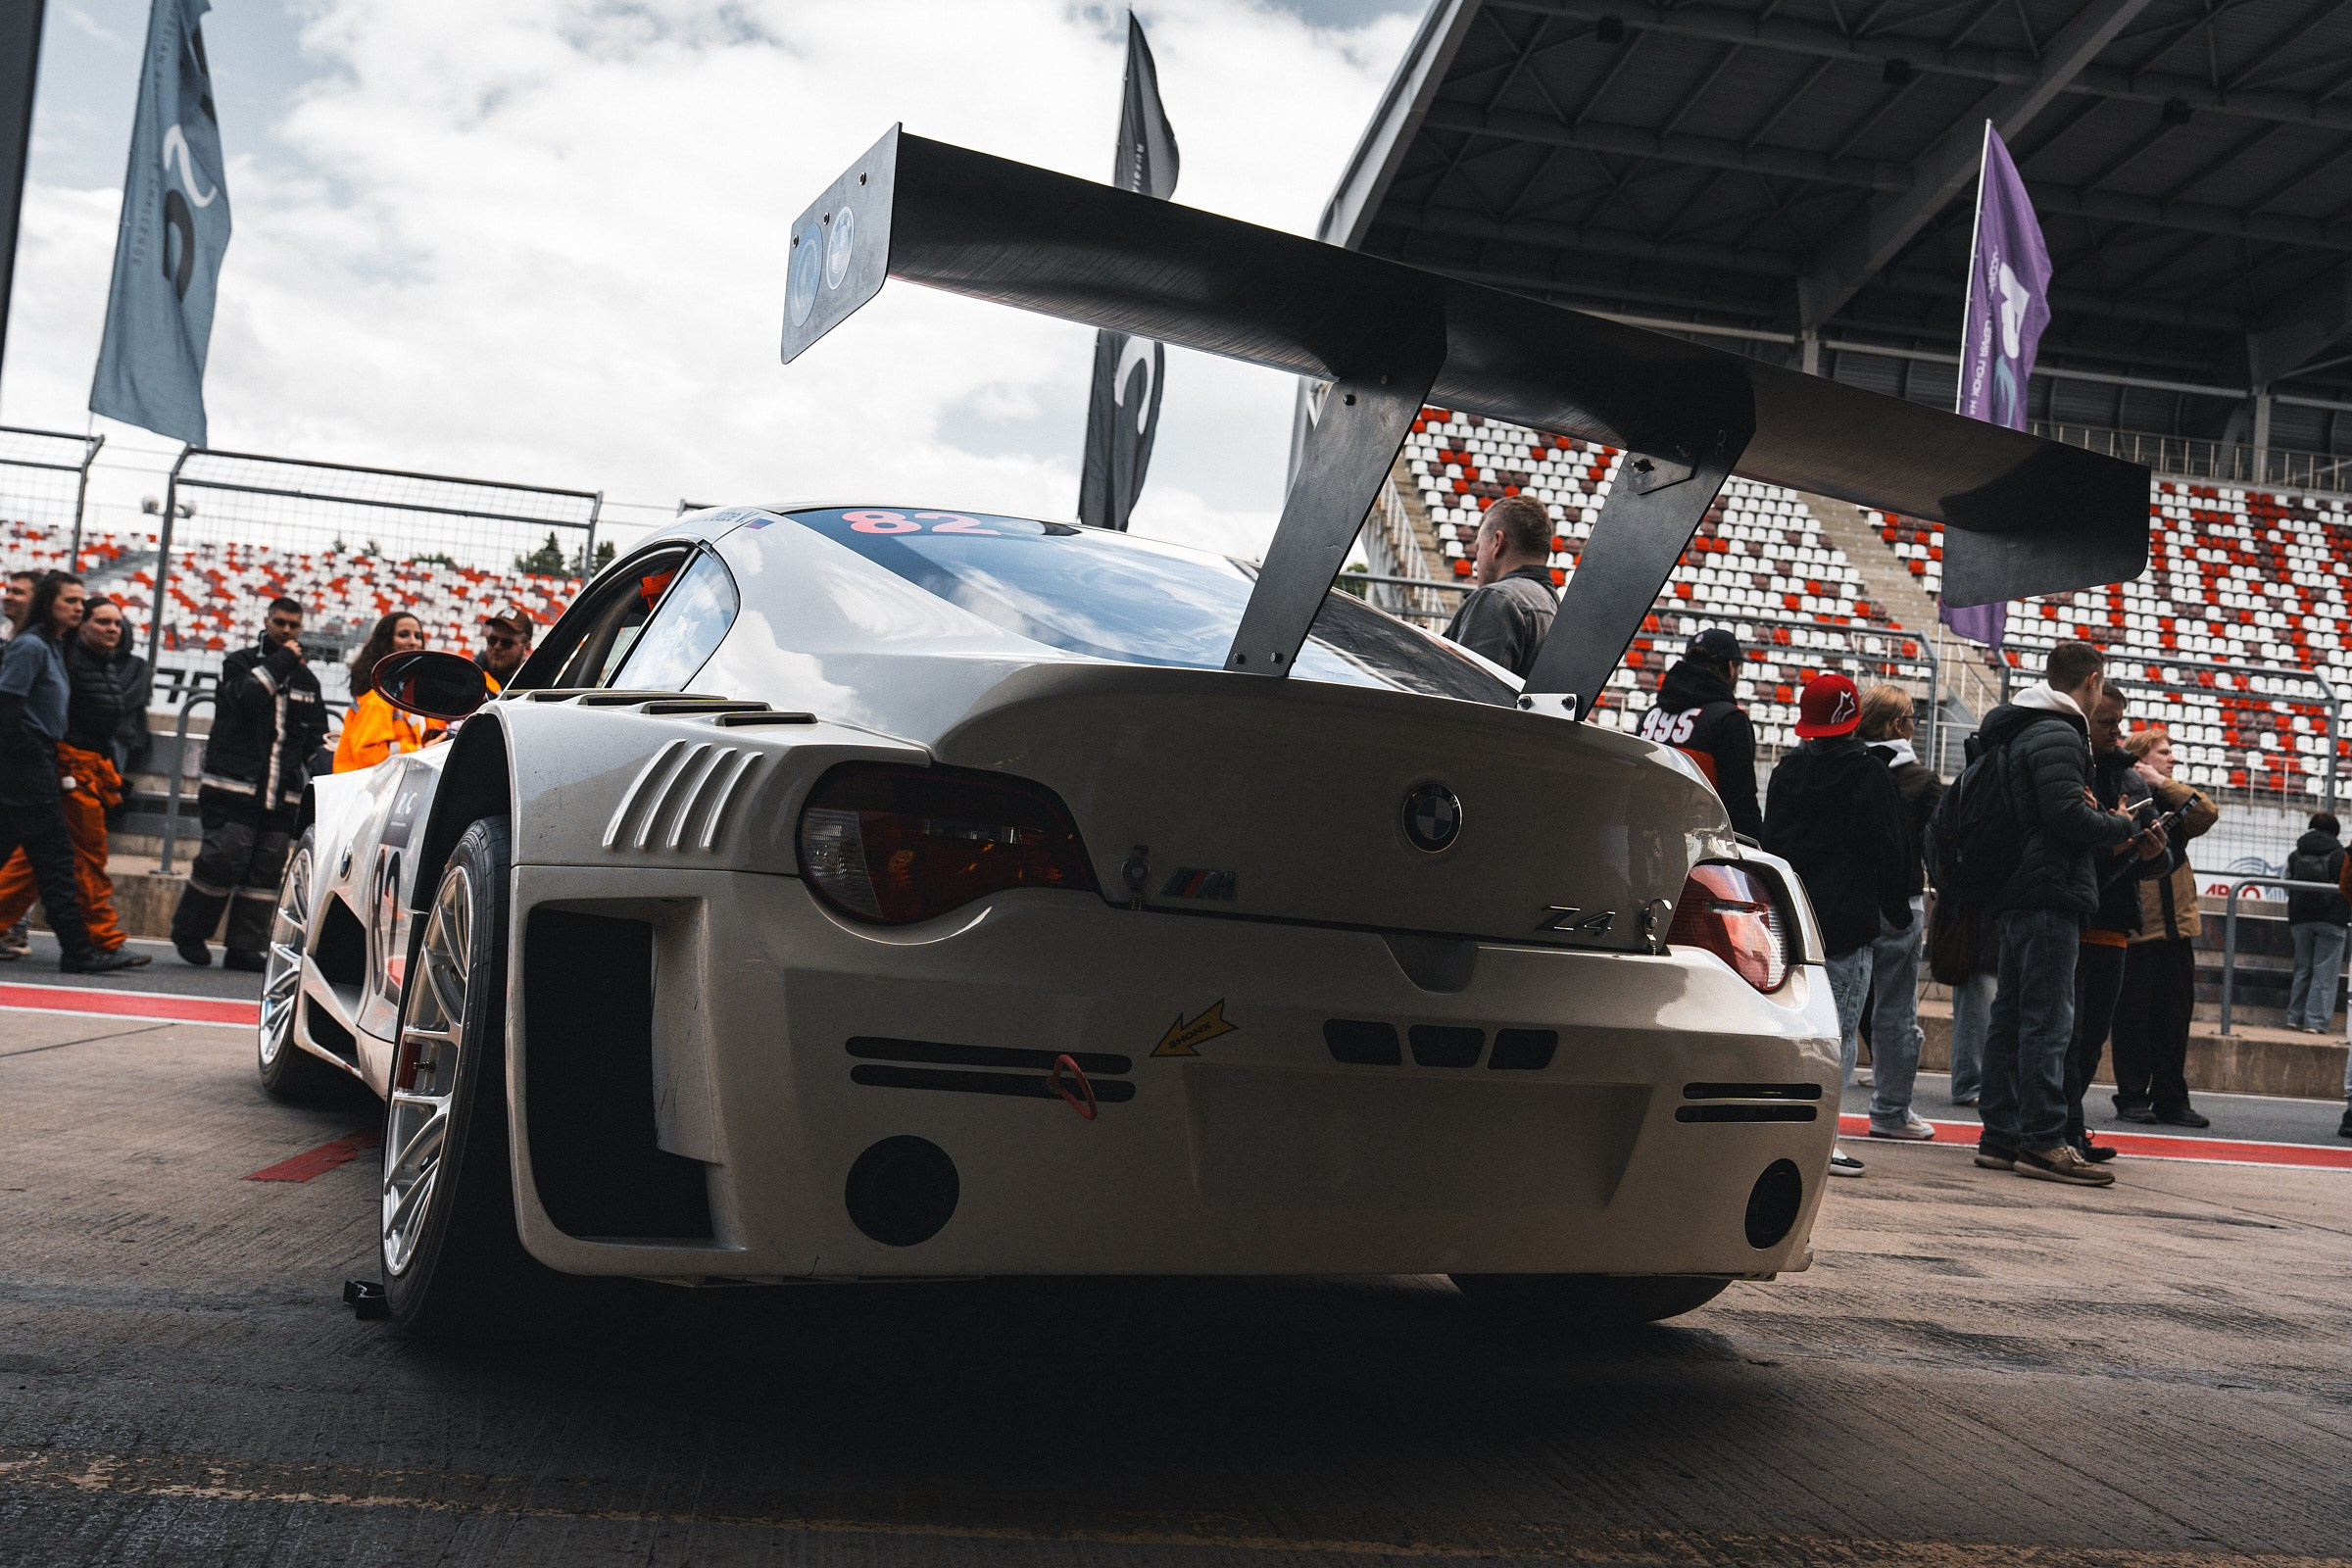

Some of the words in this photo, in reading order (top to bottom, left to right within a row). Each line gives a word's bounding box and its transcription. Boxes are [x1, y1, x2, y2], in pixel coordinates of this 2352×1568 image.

[1980, 319, 1992, 358] СЕРИЯ
[1971, 360, 1986, 398] ГОНОК
[841, 510, 1003, 536] 82
[1535, 905, 1617, 938] Z4
